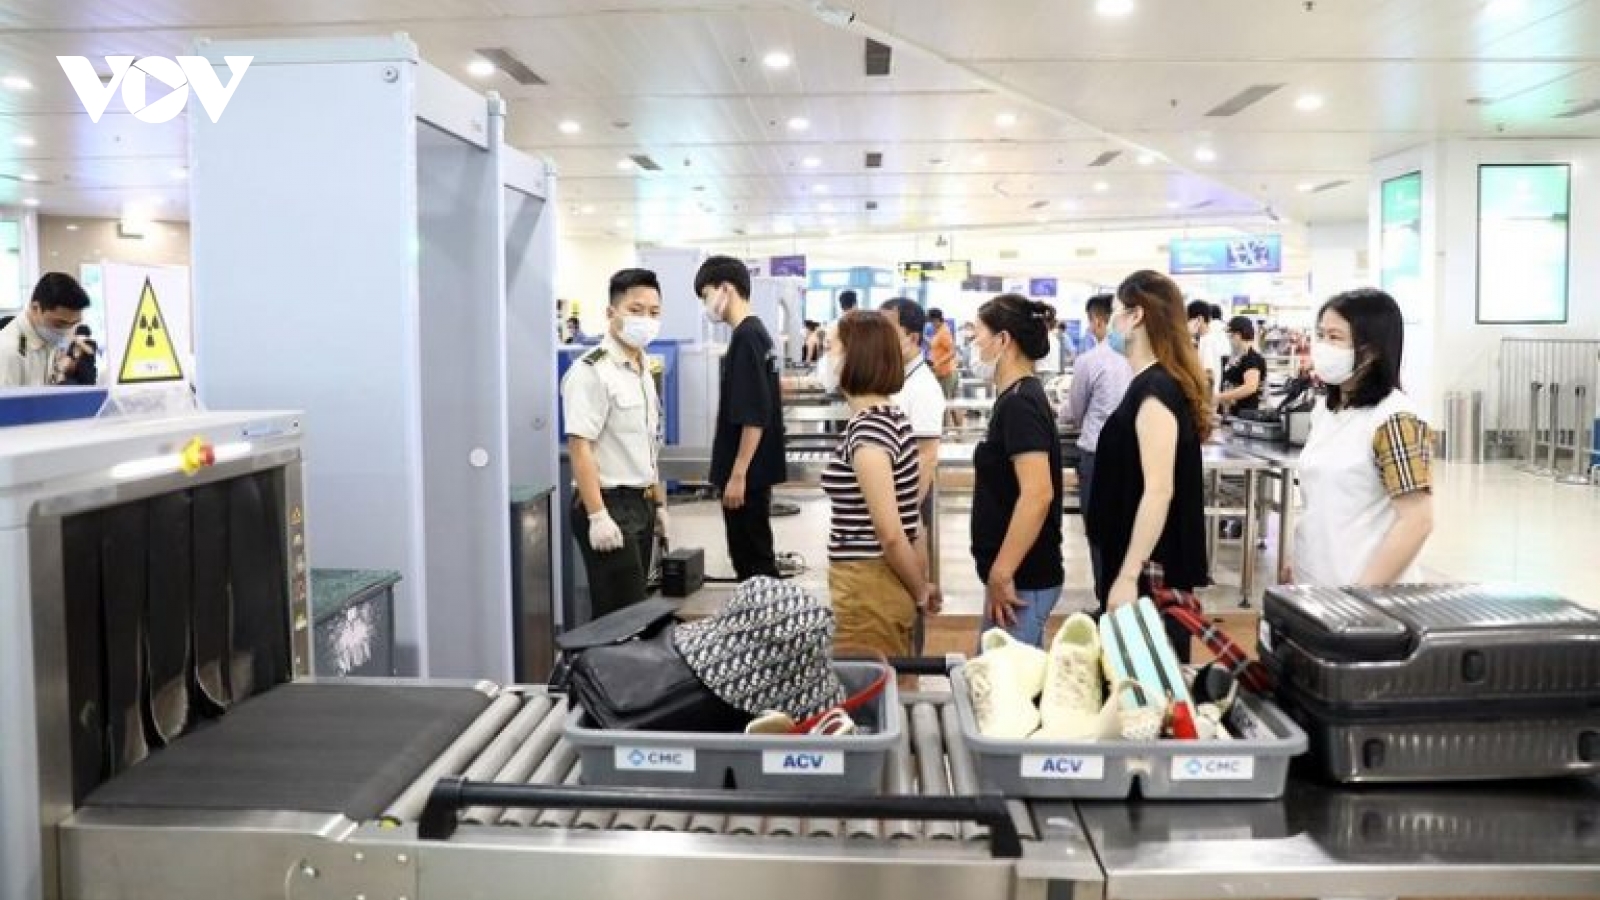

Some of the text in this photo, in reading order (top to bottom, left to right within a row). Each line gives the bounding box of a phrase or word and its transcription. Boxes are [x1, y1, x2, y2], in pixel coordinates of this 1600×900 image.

[647, 752, 682, 765] CMC
[783, 753, 824, 769] ACV
[1042, 758, 1083, 773] ACV
[1205, 759, 1240, 773] CMC
